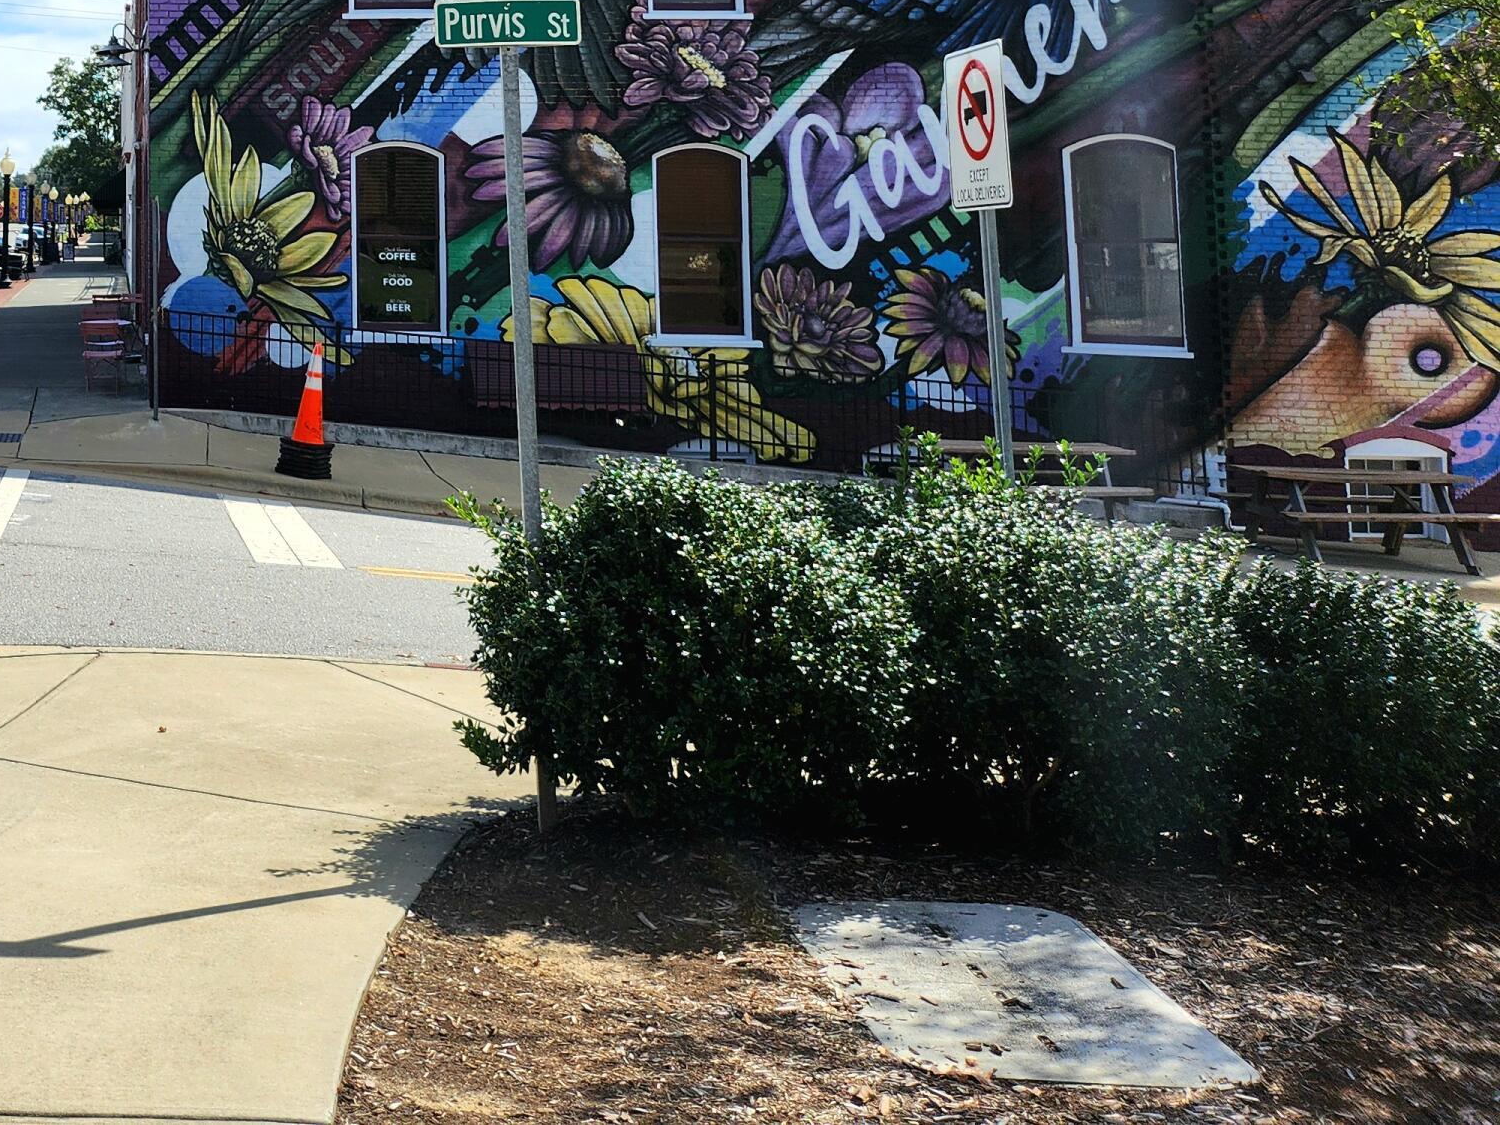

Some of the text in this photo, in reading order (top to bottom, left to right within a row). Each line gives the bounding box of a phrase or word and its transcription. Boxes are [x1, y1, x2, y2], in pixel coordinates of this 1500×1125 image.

[444, 3, 571, 41] Purvis St
[970, 168, 988, 183] EXCEPT
[957, 185, 1006, 203] LOCAL DELIVERIES
[378, 252, 417, 261] COFFEE
[383, 277, 413, 286] FOOD
[385, 303, 412, 312] BEER
